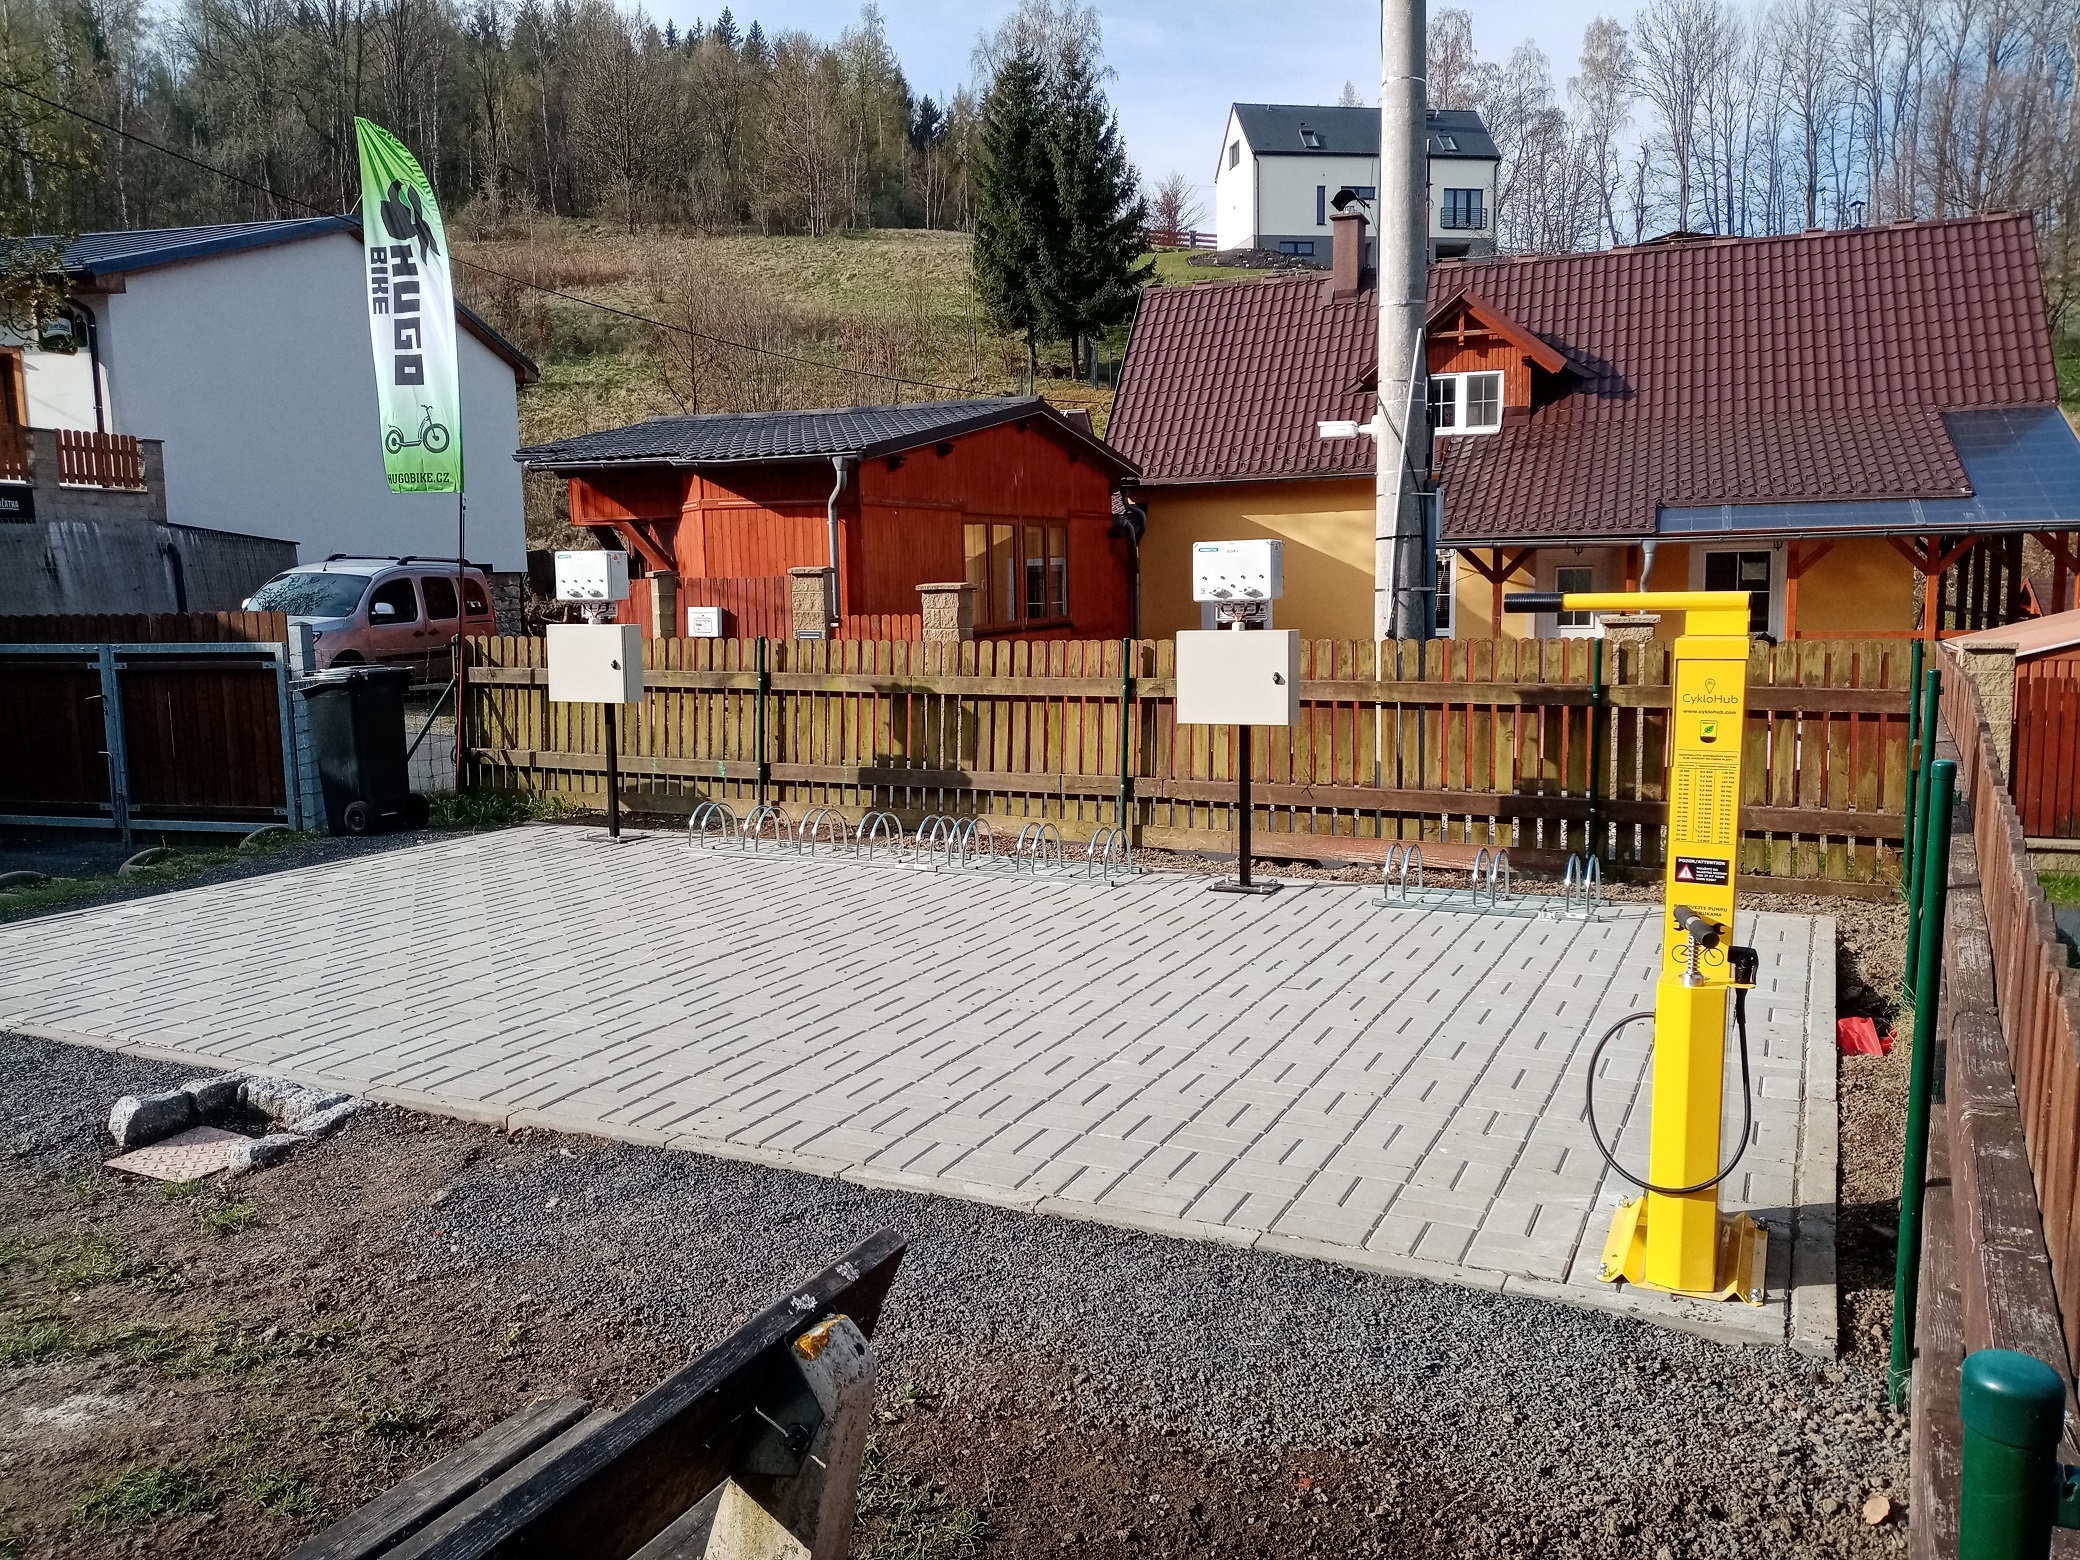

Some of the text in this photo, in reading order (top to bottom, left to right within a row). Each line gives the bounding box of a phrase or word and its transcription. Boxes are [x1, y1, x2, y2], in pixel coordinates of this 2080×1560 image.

[370, 246, 389, 314] BIKE
[390, 244, 424, 385] HUGO
[387, 472, 450, 485] HUGOBIKE.CZ
[1682, 693, 1739, 705] CykloHub
[1708, 905, 1728, 913] PUMPU
